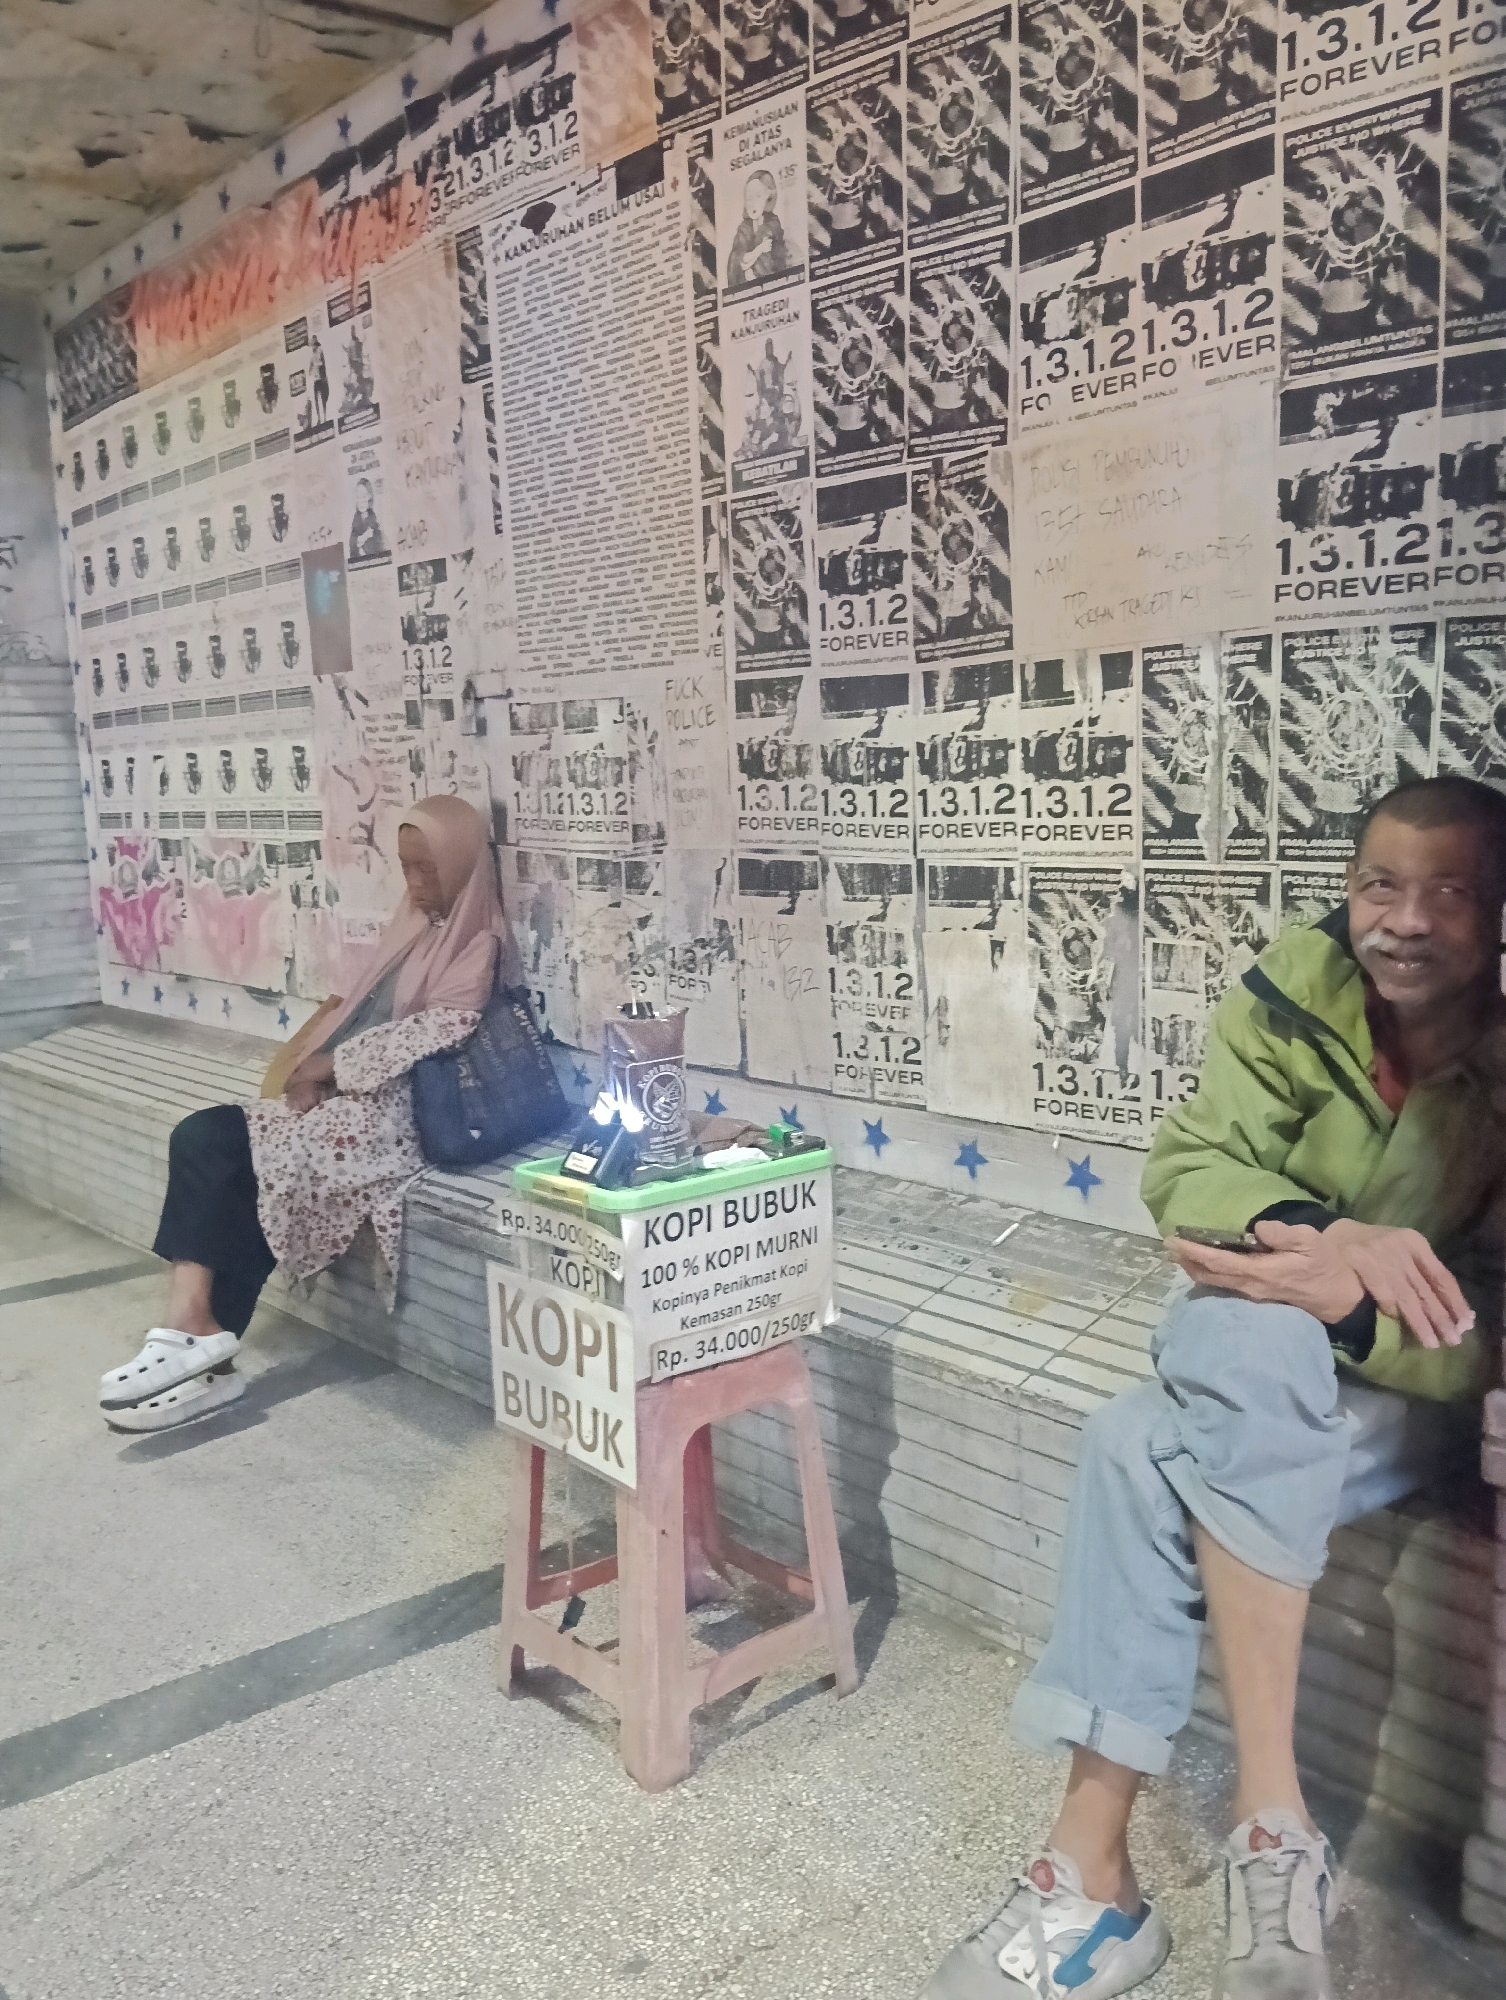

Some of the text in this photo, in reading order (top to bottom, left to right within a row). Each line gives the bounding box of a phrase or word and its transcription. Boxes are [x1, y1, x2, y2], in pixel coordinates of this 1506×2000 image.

[1282, 0, 1441, 71] 1.3.1.2
[1281, 38, 1441, 102] FOREVER
[753, 126, 782, 148] ATAS
[1142, 287, 1275, 355] 1.3.1.2
[1020, 328, 1136, 390] 1.3.1.2
[1142, 333, 1276, 383] FOEVER
[1020, 371, 1137, 415] FOEVER
[1275, 522, 1430, 576] 1.3.1.2
[1274, 571, 1430, 603] FOREVER
[820, 593, 909, 634] 1.3.1.2
[820, 630, 909, 653] FOREVER
[665, 675, 704, 702] FUCK
[665, 703, 717, 732] POLICE
[567, 791, 629, 816] 1.3.1.2
[737, 782, 819, 813] 1.3.1.2
[821, 787, 909, 819] 1.3.1.2
[917, 783, 1016, 819] 1.3.1.2
[1020, 782, 1133, 819] 1.3.1.2
[568, 820, 630, 833] FOREVER
[738, 816, 819, 833] FOREVER
[821, 821, 910, 840] FOREVER
[918, 820, 1017, 839] FOREVER
[1021, 823, 1134, 841] FOREVER
[832, 1031, 923, 1066] 1.3.1.2
[1034, 1098, 1143, 1126] FOREVER
[501, 1207, 530, 1233] Rp.
[644, 1179, 817, 1249] KOPI BUBUK
[641, 1225, 818, 1289] 100 % KOPI MURNI
[551, 1255, 604, 1301] KOPI
[652, 1259, 809, 1314] Kopinya Penikmat Kopi
[680, 1289, 783, 1332] Kemasan 250gr
[498, 1281, 618, 1393] KOPI
[656, 1309, 816, 1371] Rp. 34.000/250gr
[502, 1370, 625, 1469] BUBUK
